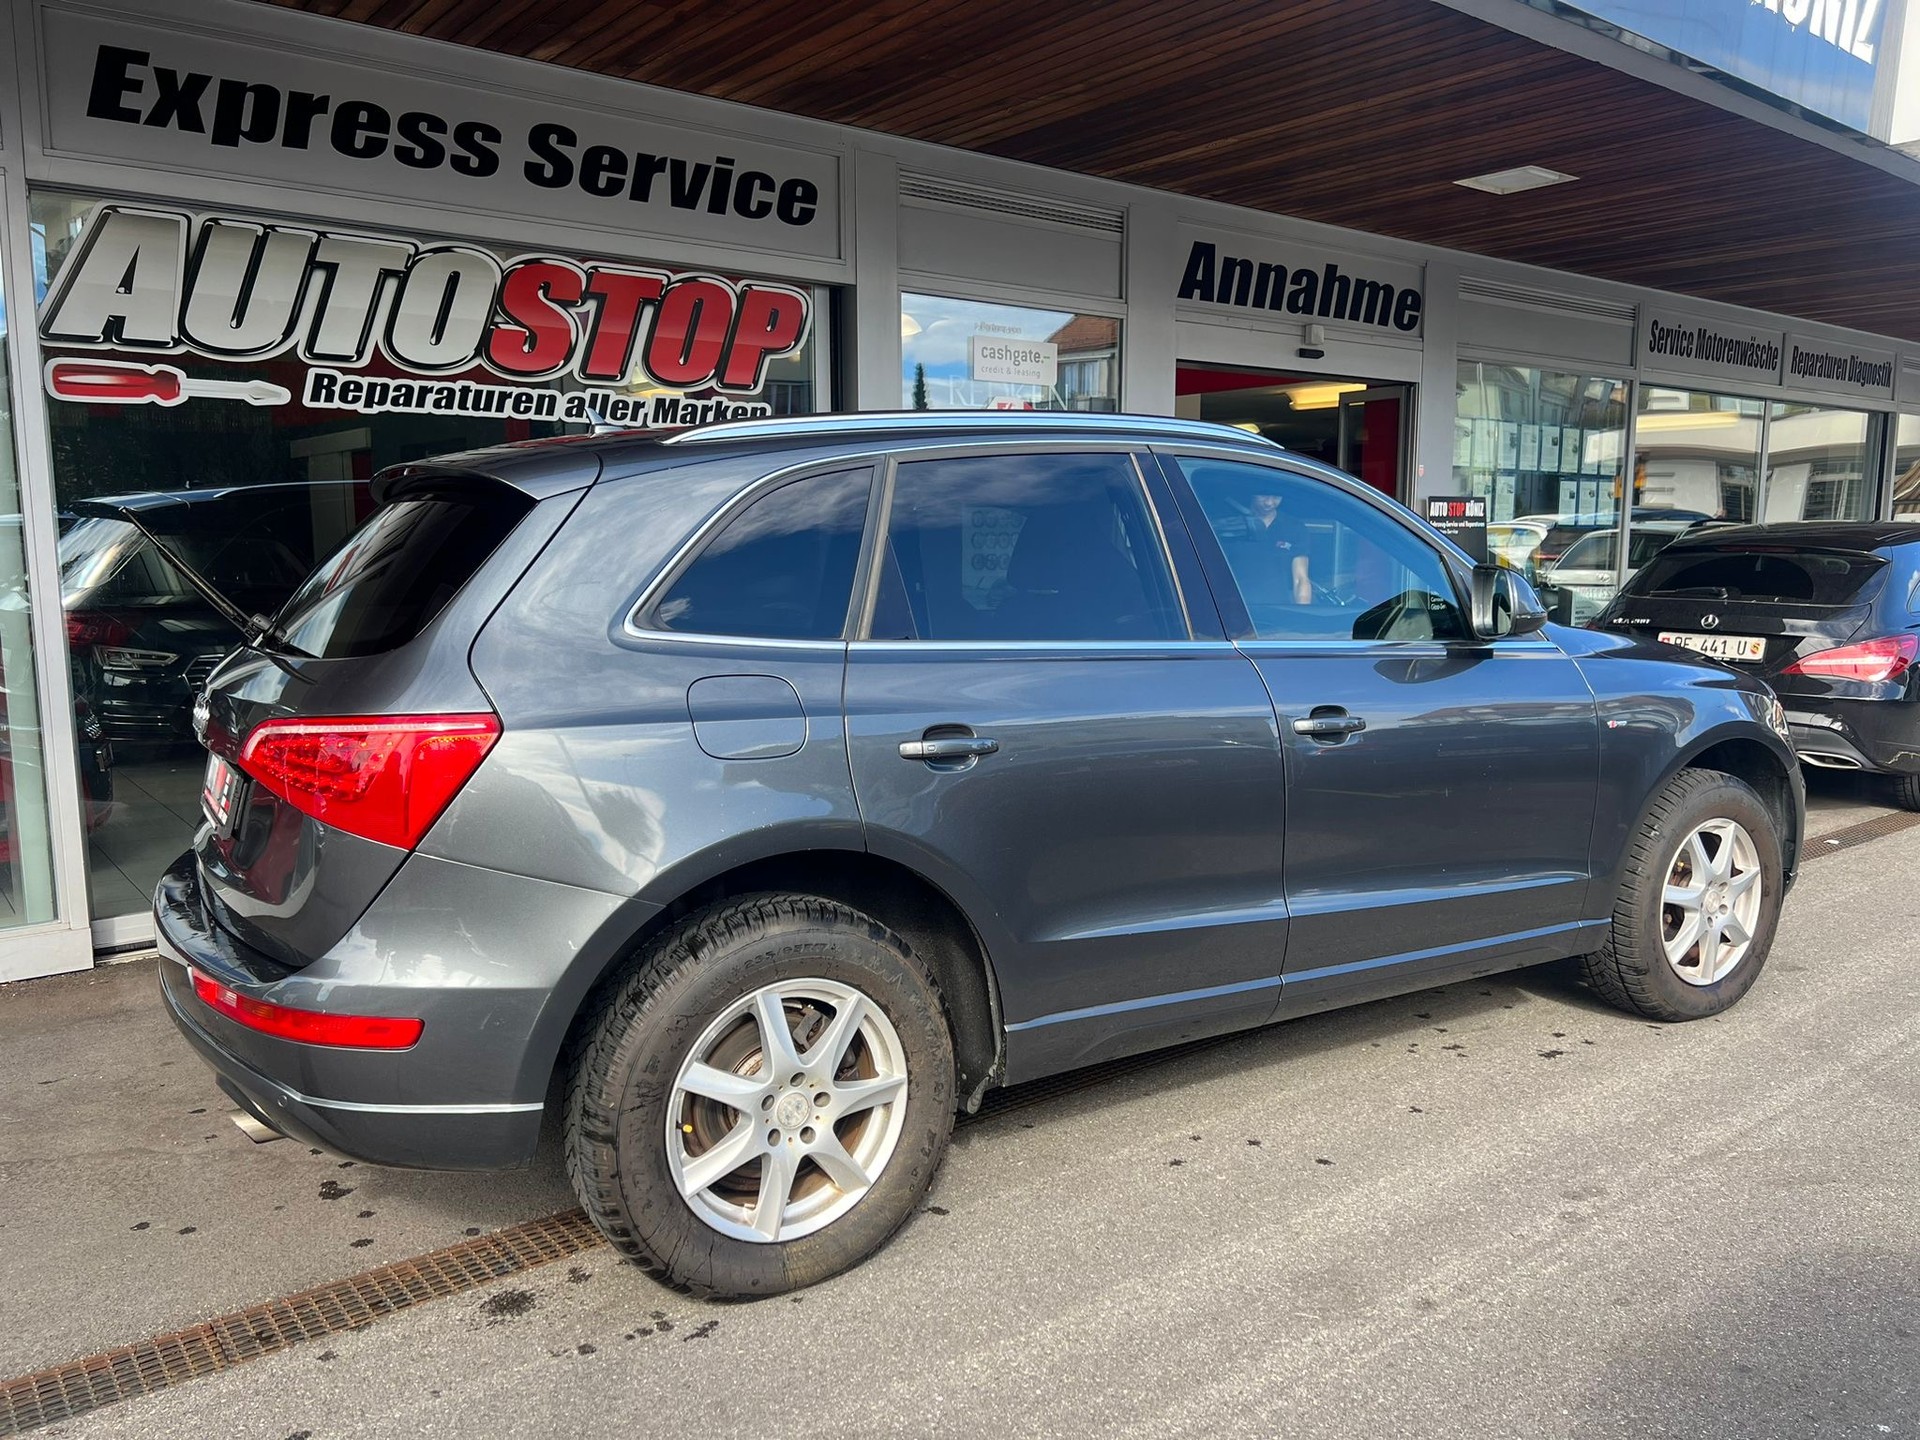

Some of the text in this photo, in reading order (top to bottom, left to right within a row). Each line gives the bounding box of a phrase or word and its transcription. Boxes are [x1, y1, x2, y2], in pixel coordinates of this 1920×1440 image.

[86, 44, 819, 227] Express Service
[42, 205, 808, 392] AUTOSTOP
[1177, 240, 1422, 332] Annahme
[1649, 319, 1779, 371] Service Motorenwäsche
[1790, 345, 1893, 388] Reparaturen Diagnostik
[981, 365, 1041, 378] credit & leasing
[311, 372, 768, 425] Reparaturen aller Marken
[1430, 501, 1448, 517] AUTO
[1448, 502, 1465, 517] STOP
[1700, 638, 1728, 655] 441
[1737, 640, 1747, 656] U
